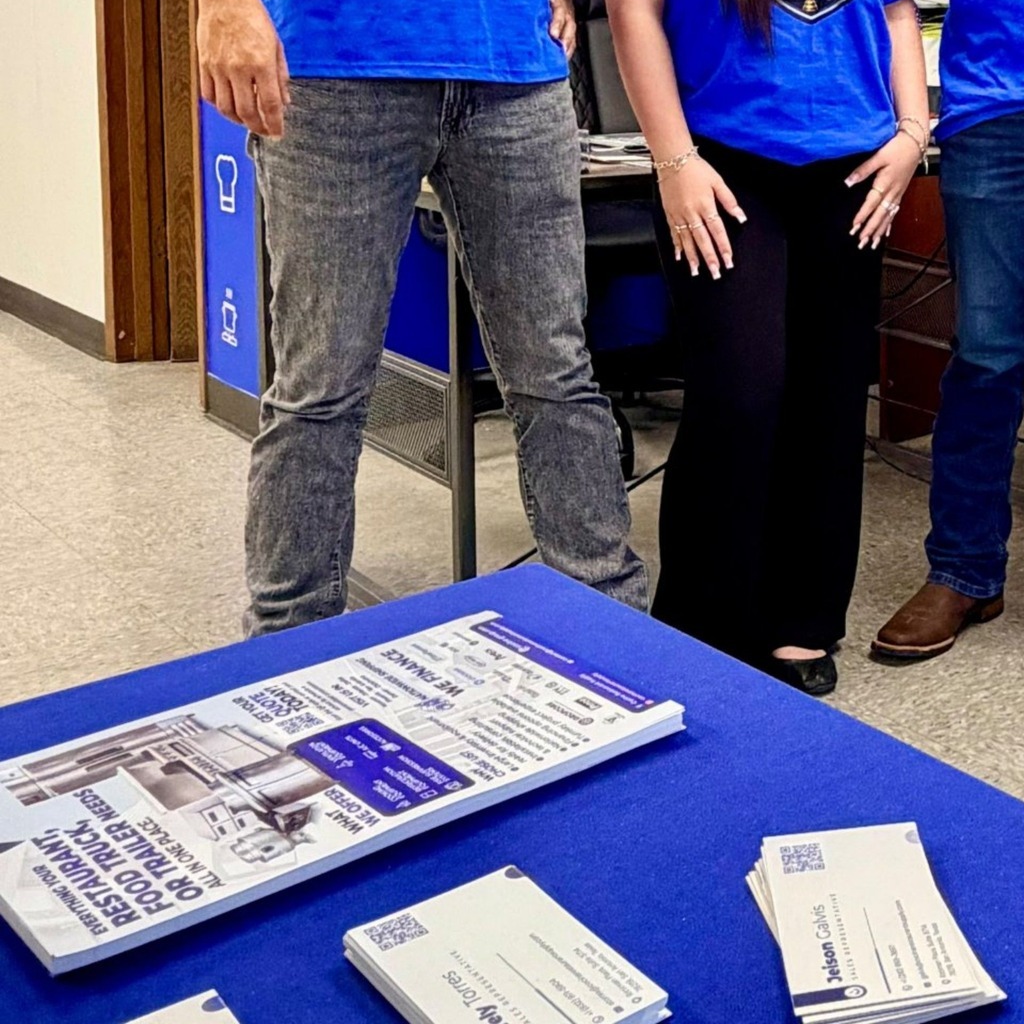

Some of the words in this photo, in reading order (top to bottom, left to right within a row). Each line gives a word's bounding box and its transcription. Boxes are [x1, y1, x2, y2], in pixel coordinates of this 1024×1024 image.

[380, 648, 441, 683] FINANCE
[263, 685, 309, 712] TODAY!
[433, 680, 465, 698] WE
[231, 696, 258, 714] YOUR
[248, 691, 292, 717] QUOTE
[251, 710, 274, 724] GET
[73, 788, 120, 822] NEEDS
[324, 787, 362, 814] OFFER
[325, 809, 364, 835] WHAT
[354, 809, 381, 828] WE
[65, 819, 127, 873] TRUCK,
[105, 820, 177, 880] TRAILER
[164, 842, 194, 863] ONE
[32, 864, 61, 888] YOUR
[33, 828, 140, 927] RESTAURANT,
[185, 861, 207, 874] IN
[198, 870, 226, 889] ALL
[114, 869, 174, 915] FOOD
[164, 875, 204, 901] OR
[52, 885, 108, 936] EVERYTHING
[821, 941, 843, 983] Jeison
[441, 970, 482, 1008] Torres
